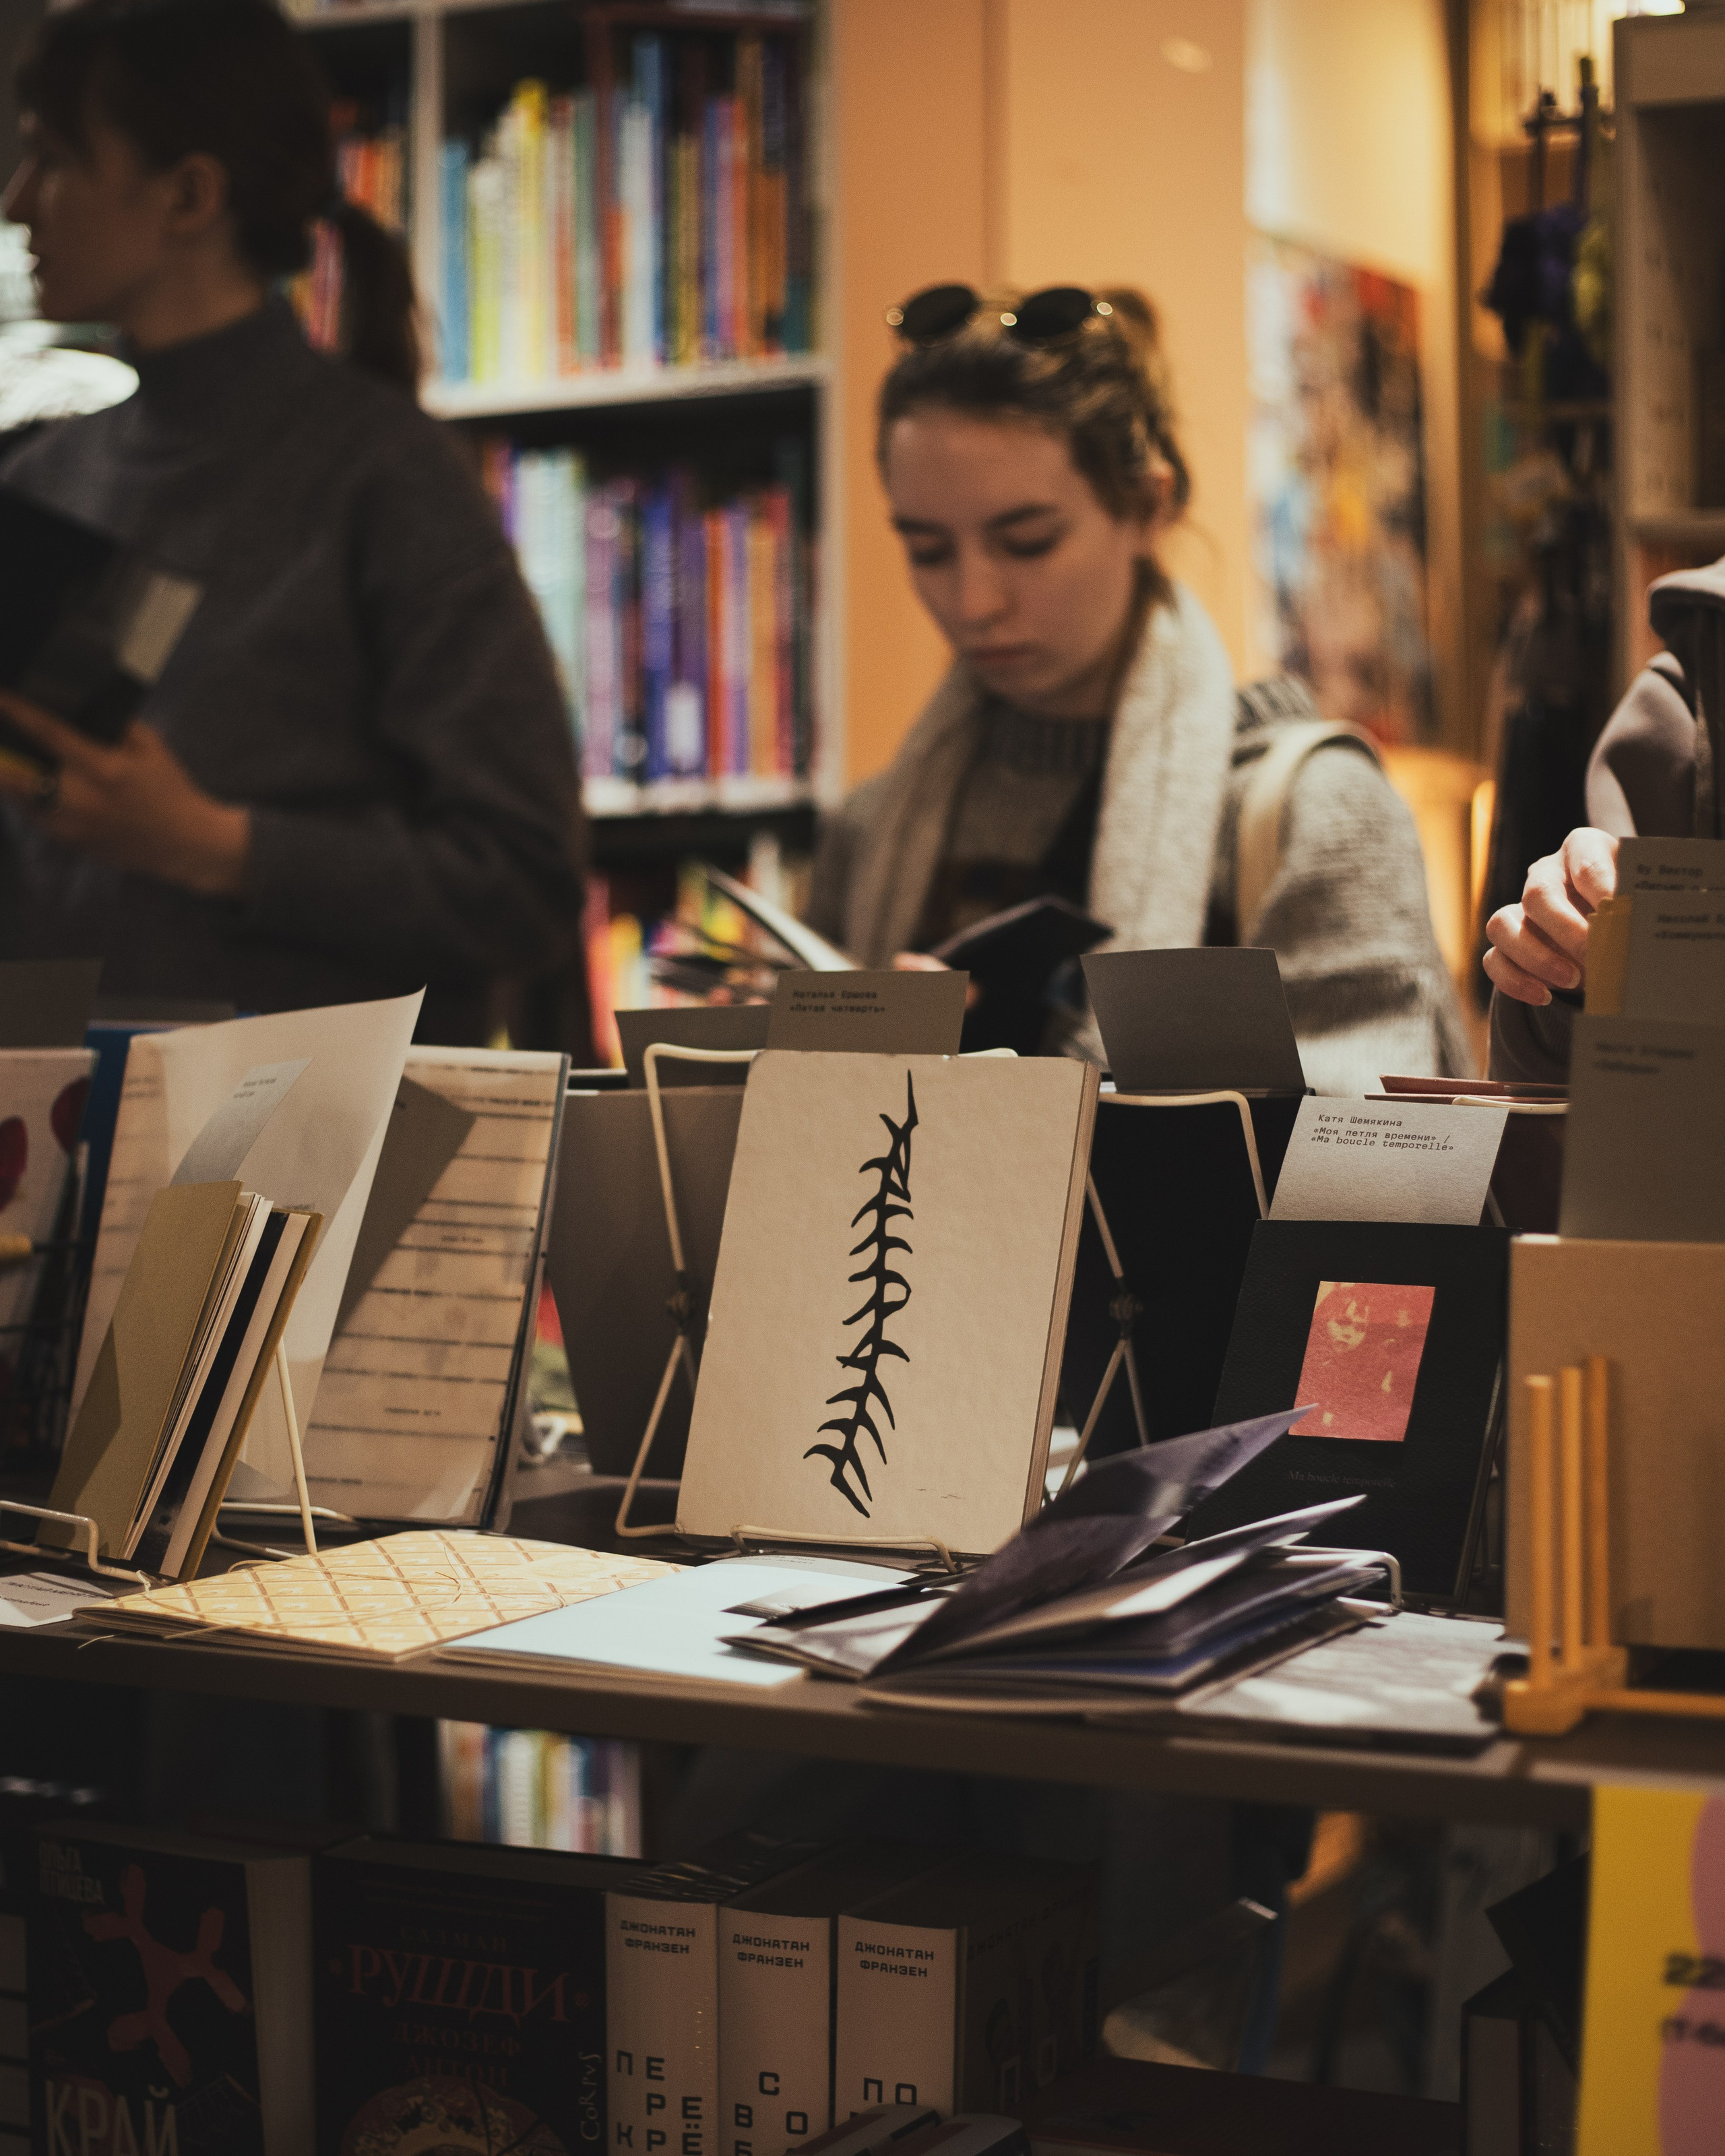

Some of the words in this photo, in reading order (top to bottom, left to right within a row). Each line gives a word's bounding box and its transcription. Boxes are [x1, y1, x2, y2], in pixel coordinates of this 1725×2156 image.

[792, 990, 835, 998] Наталья
[842, 990, 877, 999] Ершова
[832, 1005, 885, 1013] четверть»
[1318, 1114, 1343, 1122] Катя
[1350, 1116, 1403, 1127] Шемякина
[1311, 1135, 1329, 1144] «Ma
[1336, 1136, 1375, 1146] boucle
[1383, 1139, 1454, 1151] temporelle»
[1313, 1127, 1339, 1135] «Моя
[1346, 1129, 1378, 1137] петля
[1384, 1132, 1437, 1141] времени»
[1307, 1471, 1341, 1484] boucle
[1342, 1476, 1397, 1488] temporelle
[620, 1920, 695, 1938] ДЖОНАТАН
[400, 1925, 509, 1953] САЛМАН
[625, 1938, 690, 1955] ФРАНЗЕН
[732, 1933, 810, 1951] ДЖОНАТАН
[854, 1941, 934, 1961] ДЖОНАТАН
[736, 1952, 804, 1969] ФРАНЗЕН
[859, 1959, 928, 1977] ФРАНЗЕН
[346, 1943, 571, 2030] РУШДИ
[390, 2021, 522, 2058] ДЖОЗЕФ
[404, 2054, 507, 2088] АНТОН
[45, 2079, 179, 2156] КРАЙ
